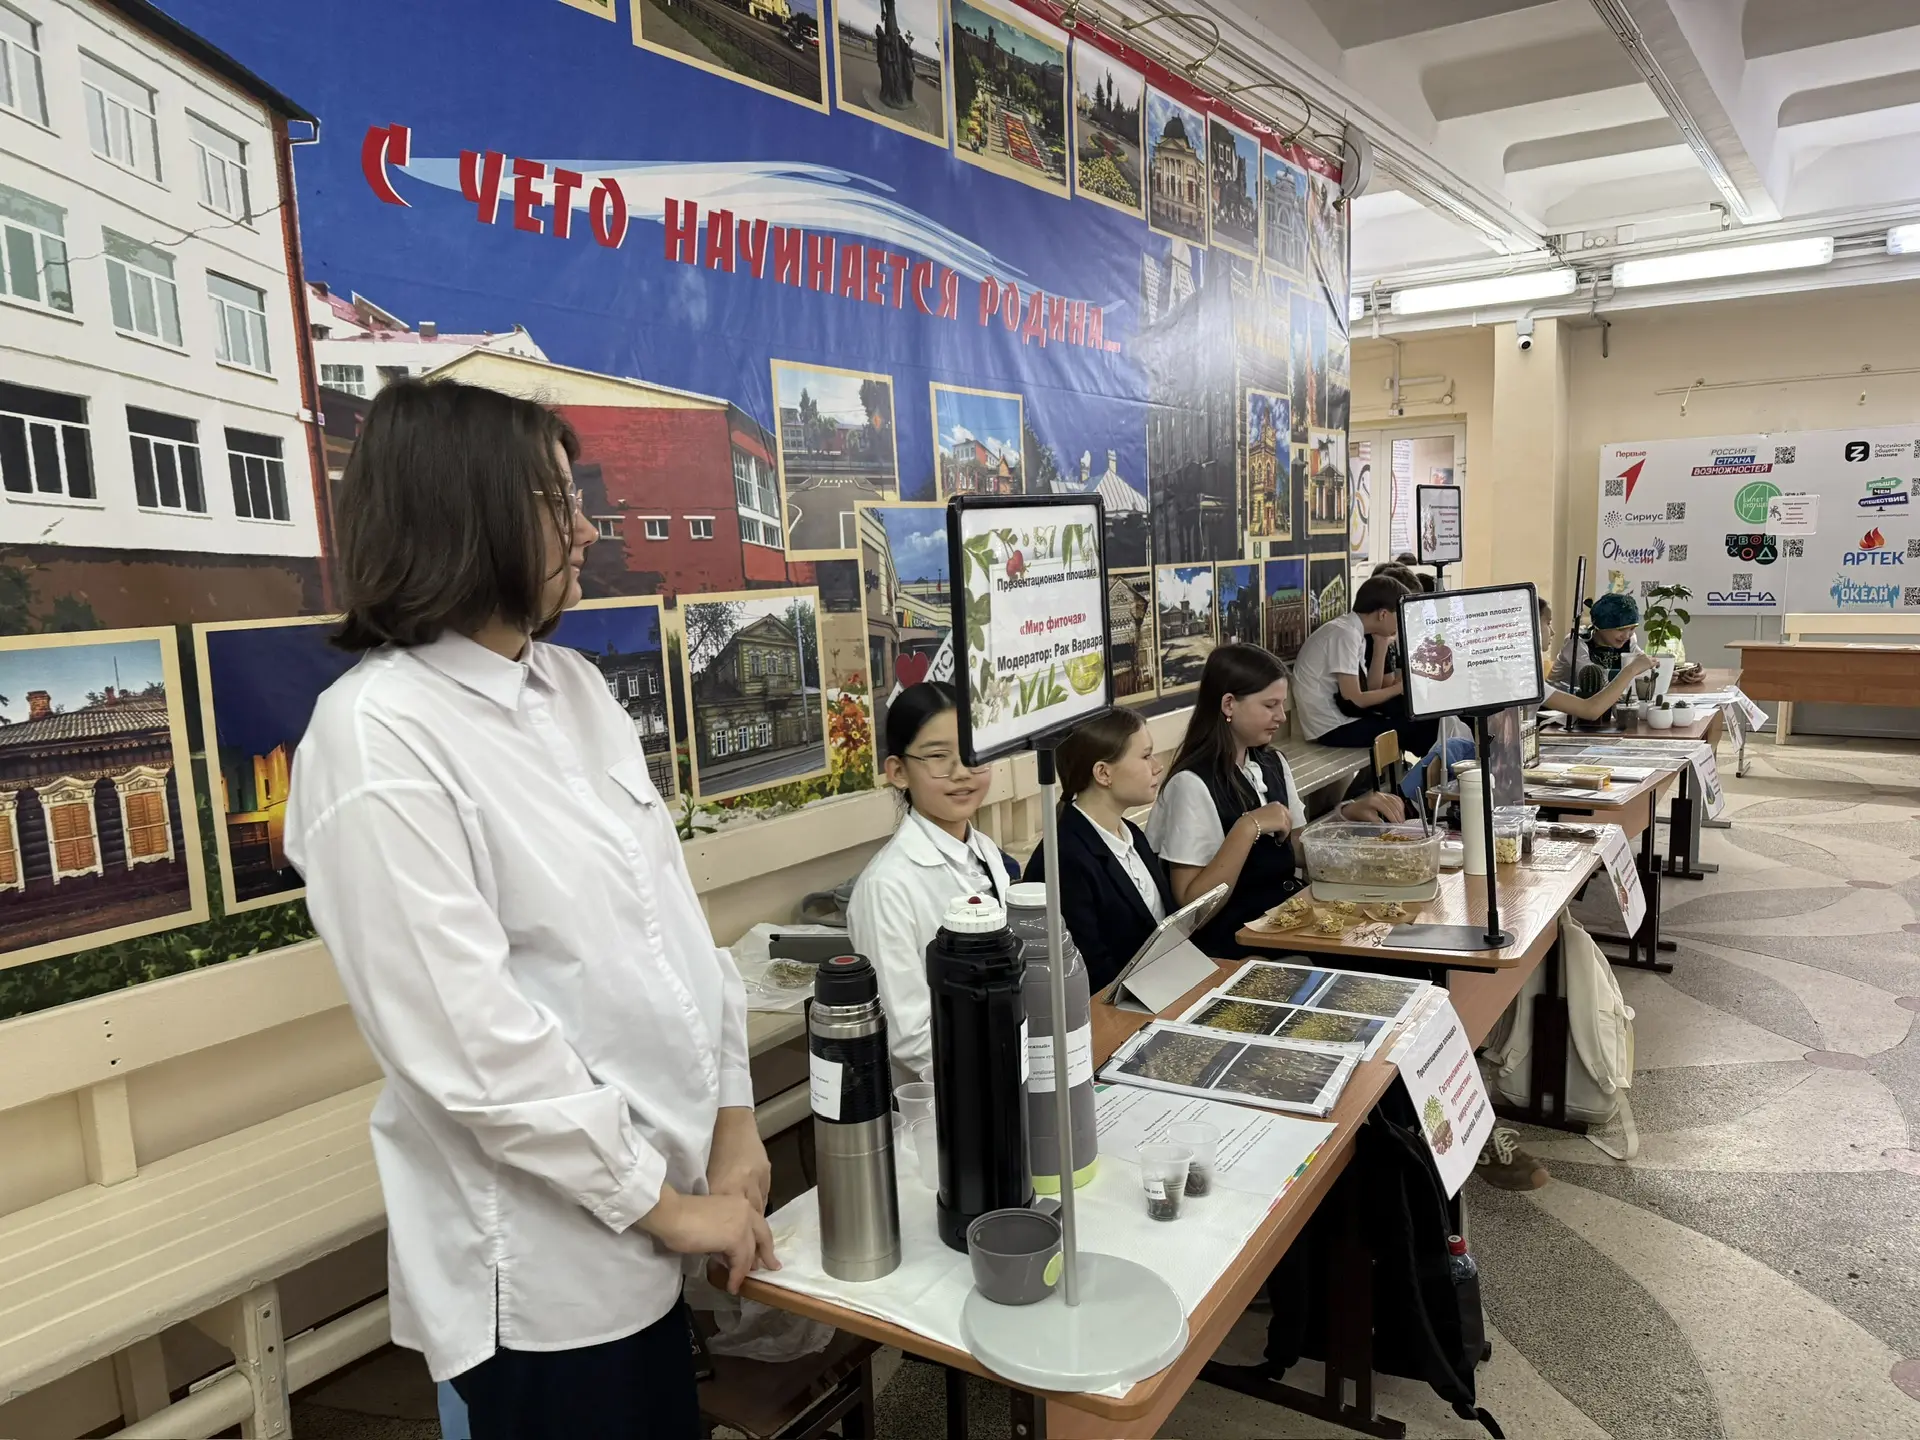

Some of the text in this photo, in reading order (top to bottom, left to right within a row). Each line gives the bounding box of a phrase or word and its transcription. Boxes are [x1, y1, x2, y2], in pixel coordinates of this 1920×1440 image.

[361, 122, 412, 207] С
[459, 149, 629, 249] ЧЕГО
[664, 197, 960, 320] НАЧИНАЕТСЯ
[1615, 450, 1647, 458] Первые
[1711, 448, 1747, 456] РОССИЯ
[1716, 457, 1751, 465] СТРАНА
[1693, 464, 1768, 476] ВОЗМОЖНОСТЕЙ
[1625, 512, 1663, 522] Сириус
[1843, 551, 1905, 566] АРТЕК
[997, 567, 1098, 592] Презентационная площадка
[1707, 592, 1776, 602] СМЕНА
[1841, 588, 1889, 600] ОКЕАН
[1019, 612, 1087, 636] «Мир фиточая»
[997, 634, 1103, 672] Модератор: Рак Варвара
